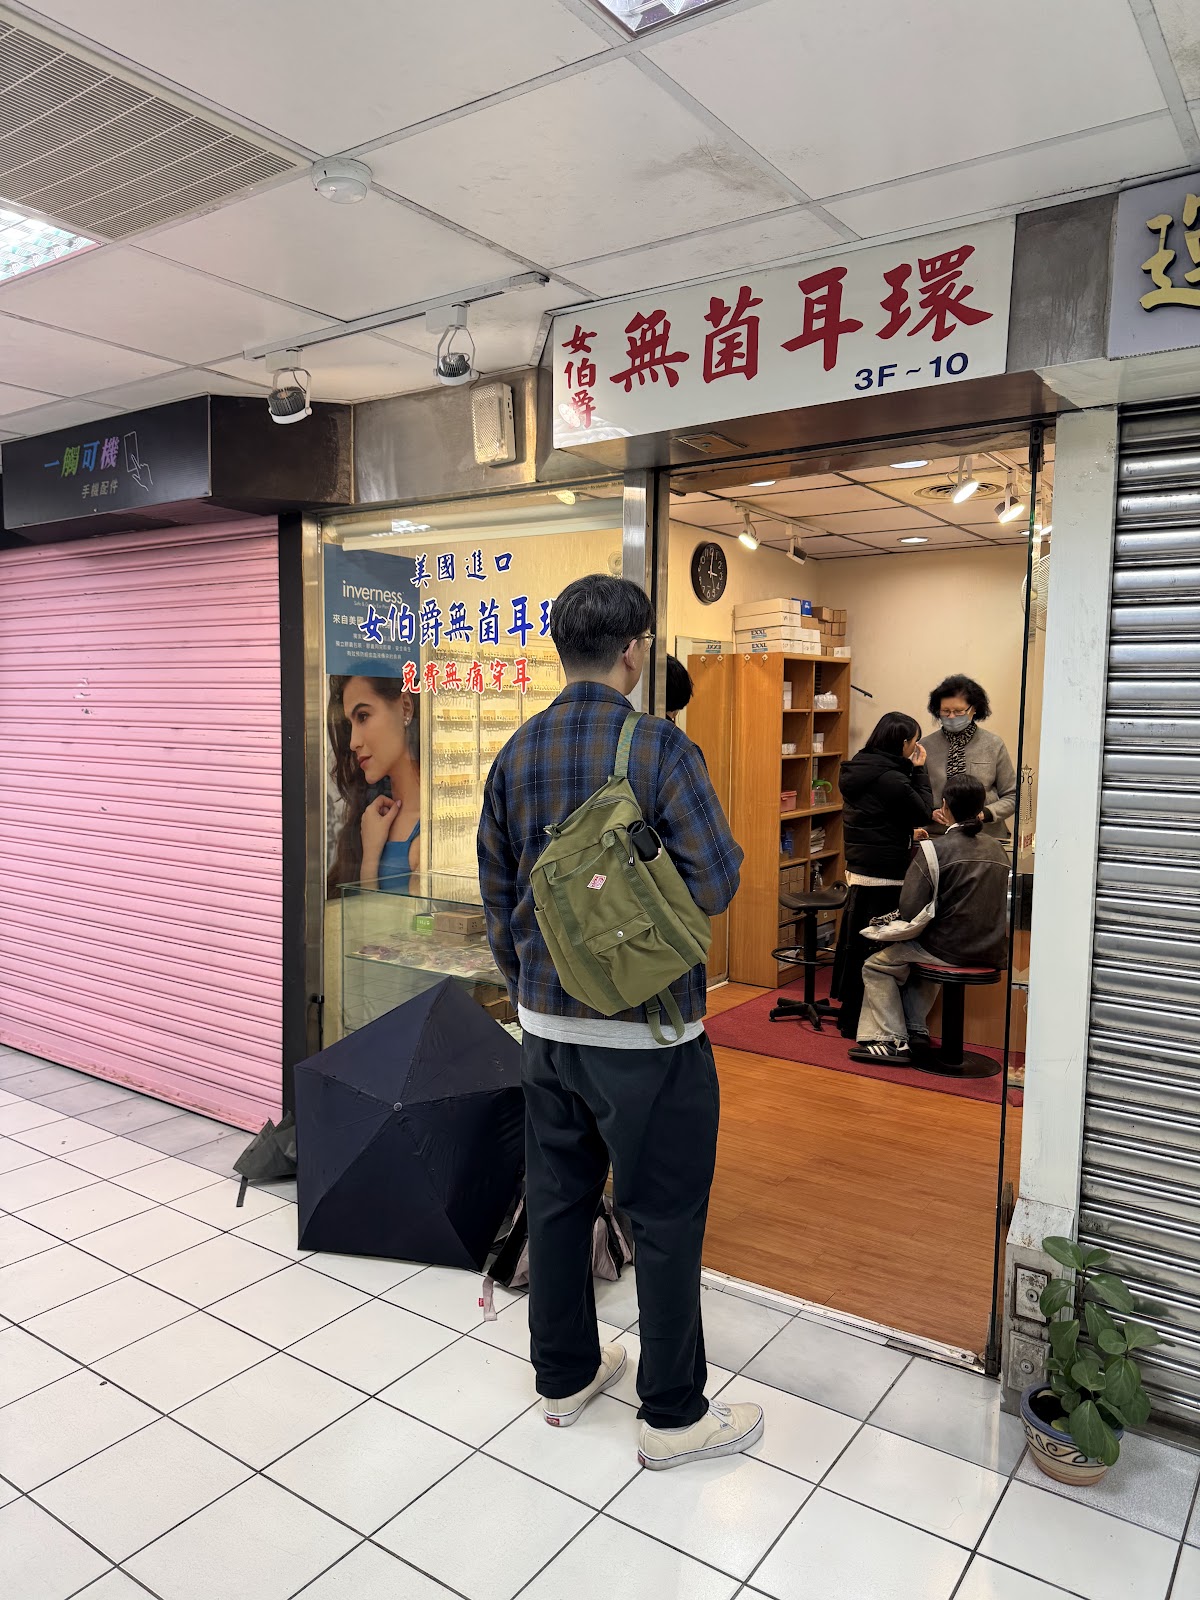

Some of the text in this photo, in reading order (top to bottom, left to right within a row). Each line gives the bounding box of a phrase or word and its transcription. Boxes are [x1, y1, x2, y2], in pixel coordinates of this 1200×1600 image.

[609, 245, 994, 393] 無菌耳環
[562, 325, 598, 430] 女伯爵
[44, 436, 120, 477] 一觸可機
[410, 549, 514, 588] 美國進口
[342, 580, 404, 605] inverness
[400, 658, 533, 696] 免費無痛穿耳
